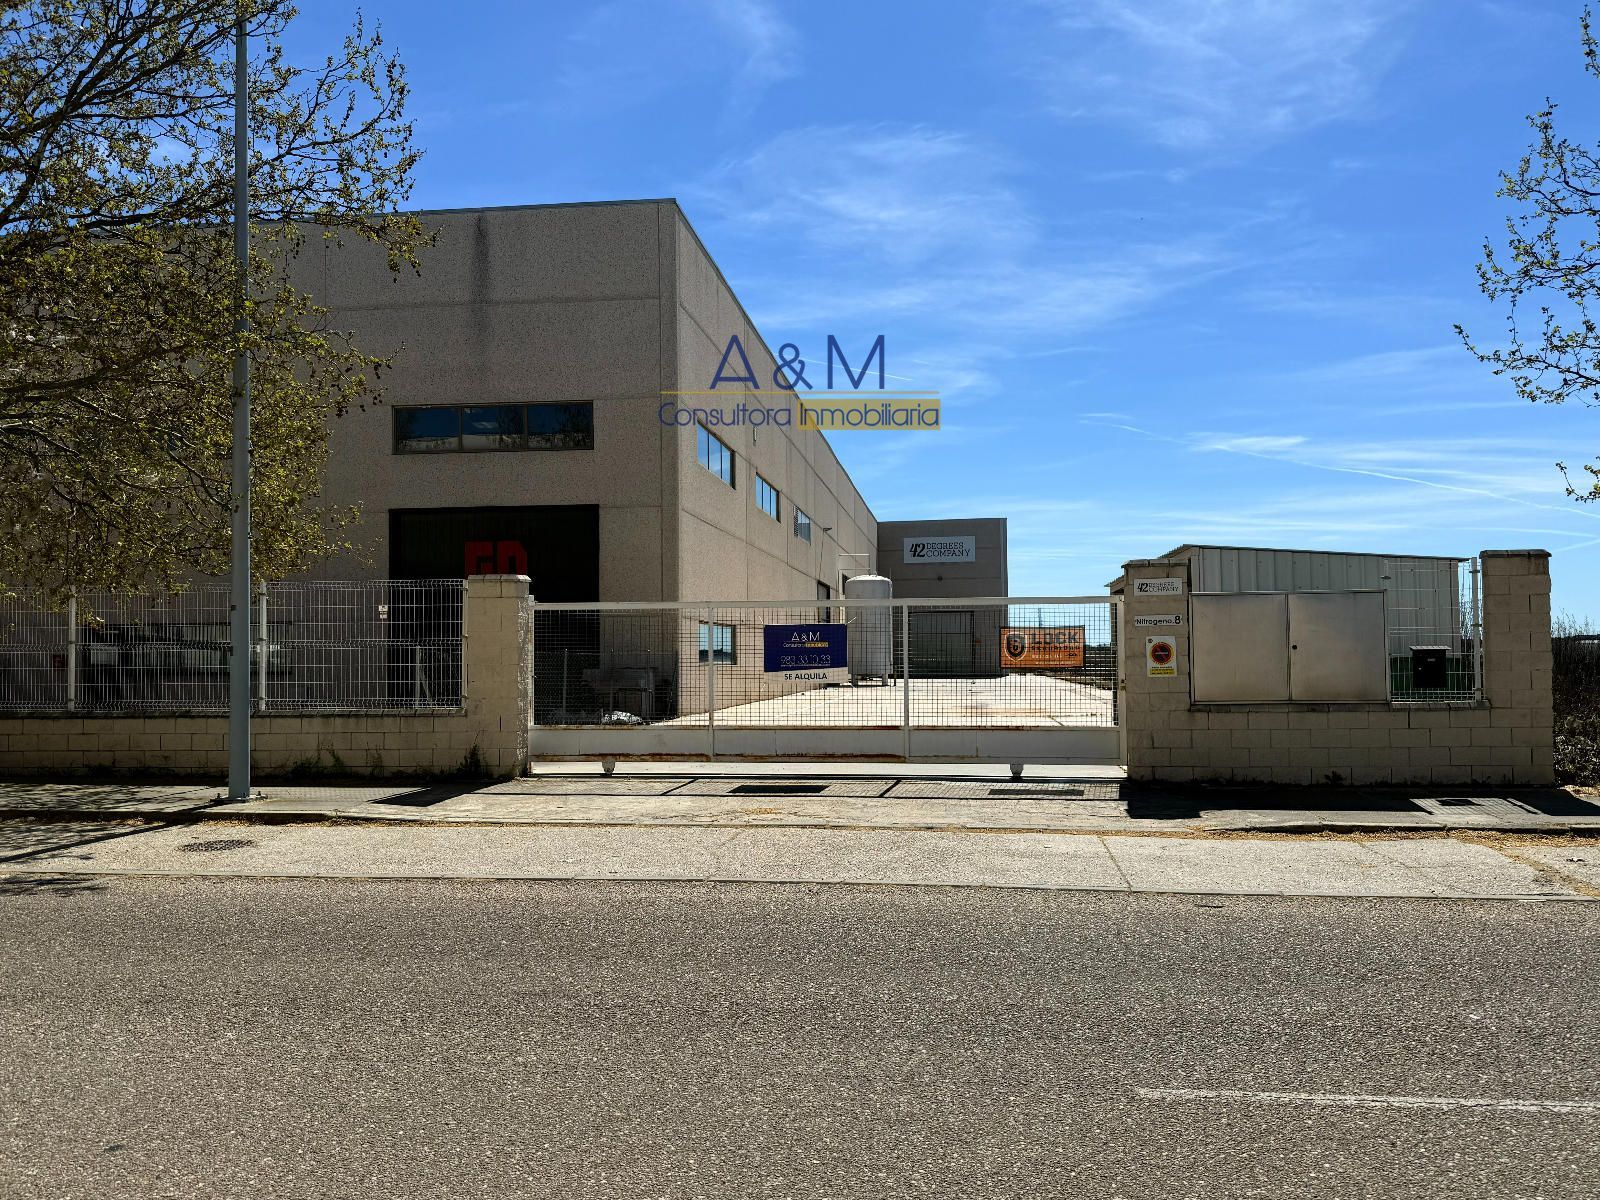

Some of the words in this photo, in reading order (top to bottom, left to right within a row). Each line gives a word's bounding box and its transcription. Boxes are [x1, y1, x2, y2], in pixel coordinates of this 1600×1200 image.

[909, 543, 926, 558] 42
[926, 542, 964, 550] DEGREES
[926, 548, 971, 558] COMPANY
[1137, 582, 1149, 593] 42
[1031, 632, 1079, 644] LOCK
[784, 673, 793, 681] SE
[794, 672, 828, 681] ALQUILA
